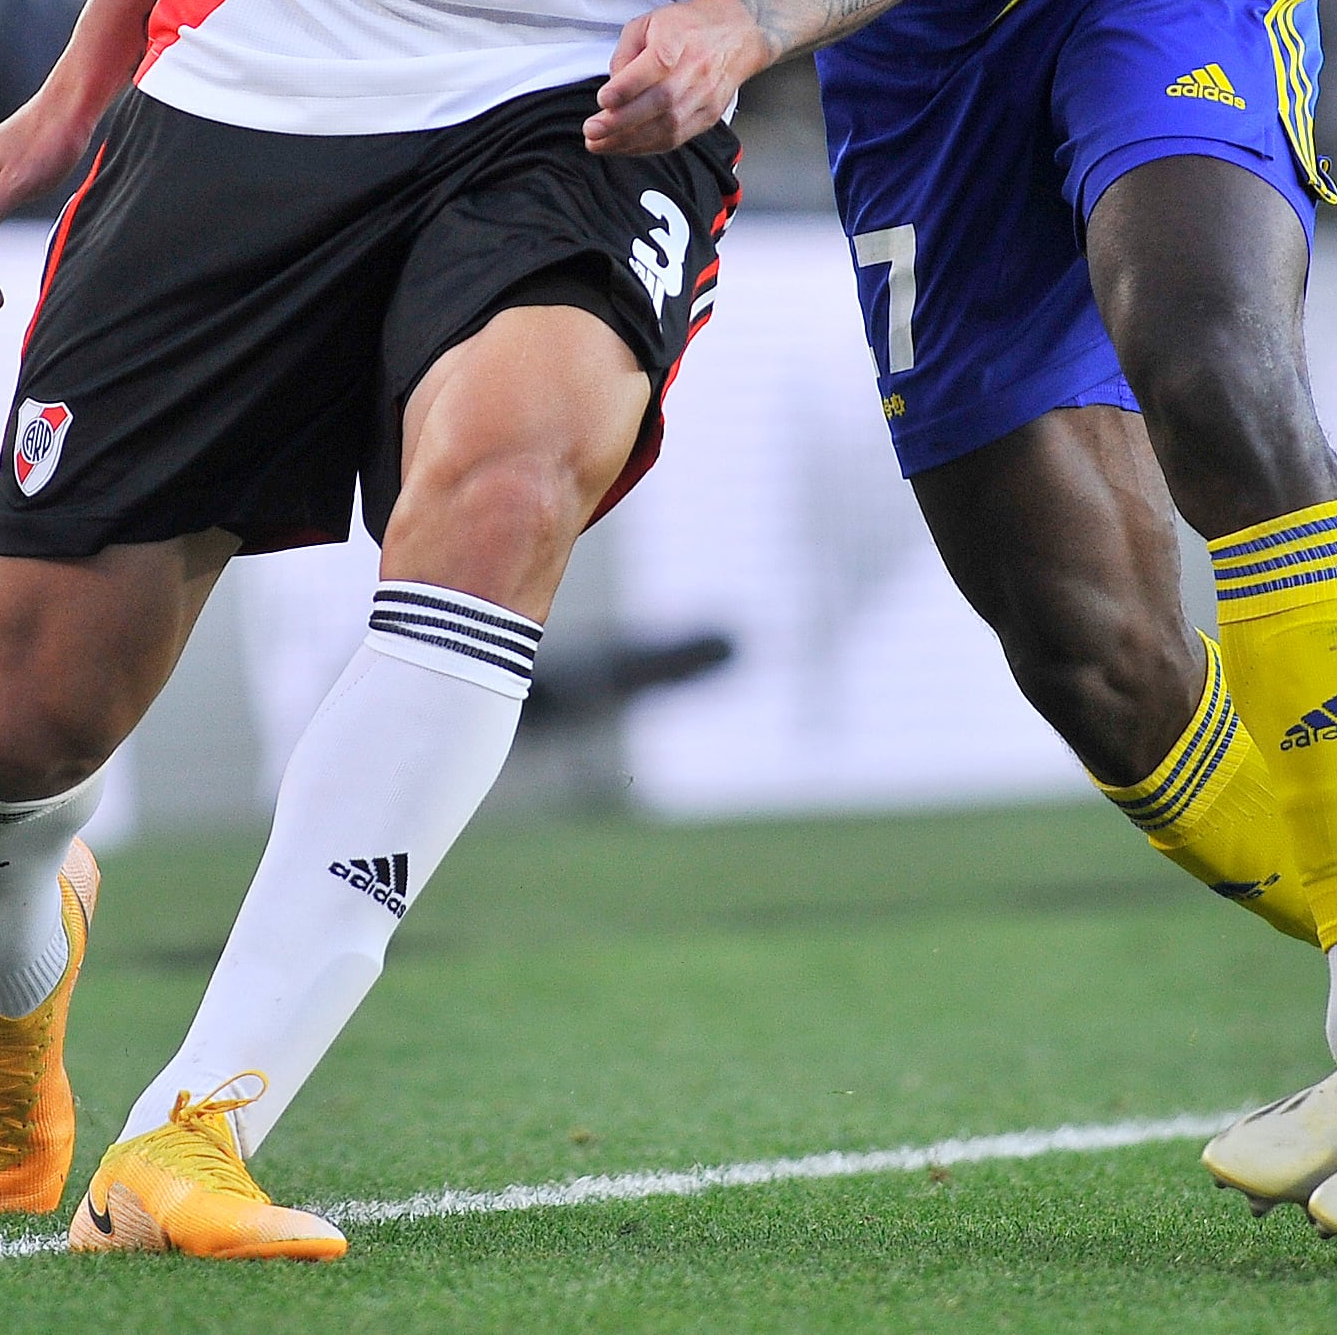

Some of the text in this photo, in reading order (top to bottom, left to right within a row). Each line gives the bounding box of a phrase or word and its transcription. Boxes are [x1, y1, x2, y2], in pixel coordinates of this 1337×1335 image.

[1166, 82, 1247, 111] adidas
[631, 188, 691, 298] 3
[853, 223, 917, 379] 7
[328, 861, 407, 920] adidas
